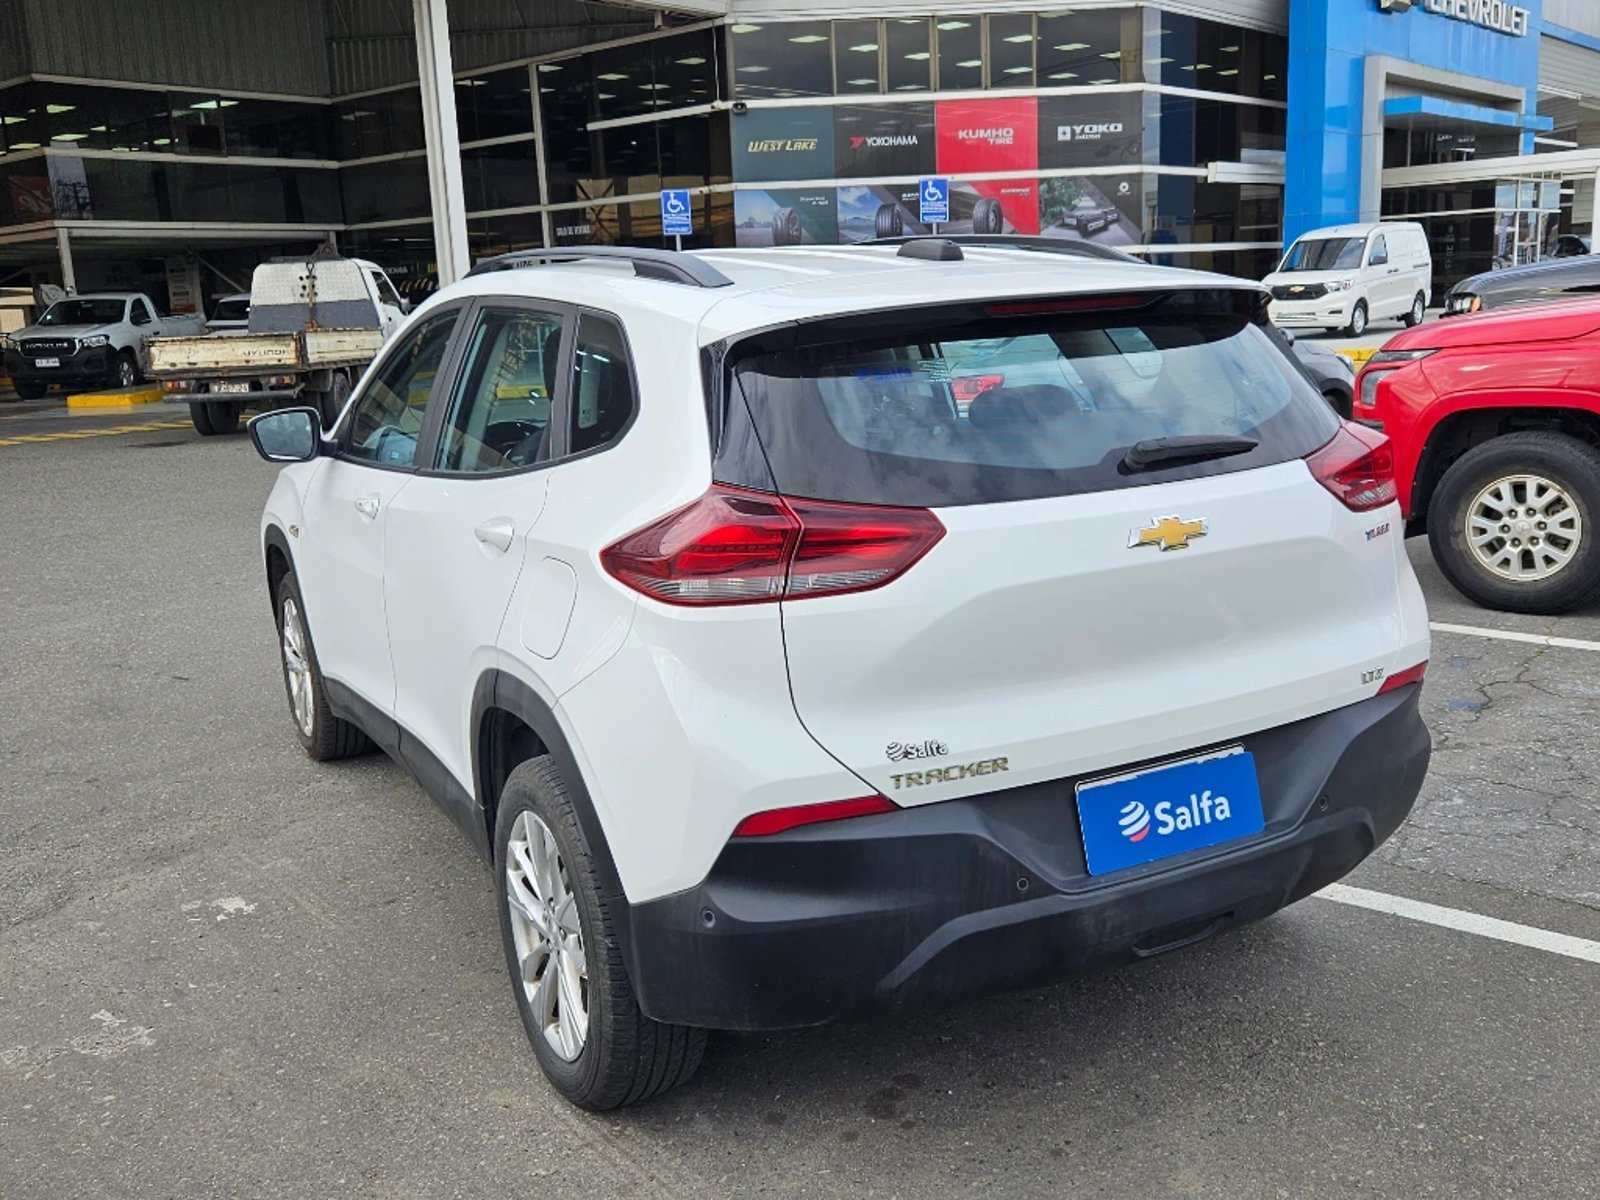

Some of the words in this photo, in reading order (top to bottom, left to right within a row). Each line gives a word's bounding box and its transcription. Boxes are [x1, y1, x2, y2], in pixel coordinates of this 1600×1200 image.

[958, 128, 1014, 139] KUMHO
[1072, 123, 1123, 134] YOKO
[748, 140, 782, 153] WEST
[785, 138, 817, 151] LAKE
[865, 135, 918, 147] YOKOHAMA
[904, 739, 949, 760] Salfa
[890, 757, 1009, 790] TRACKER
[1155, 790, 1231, 835] Salfa
